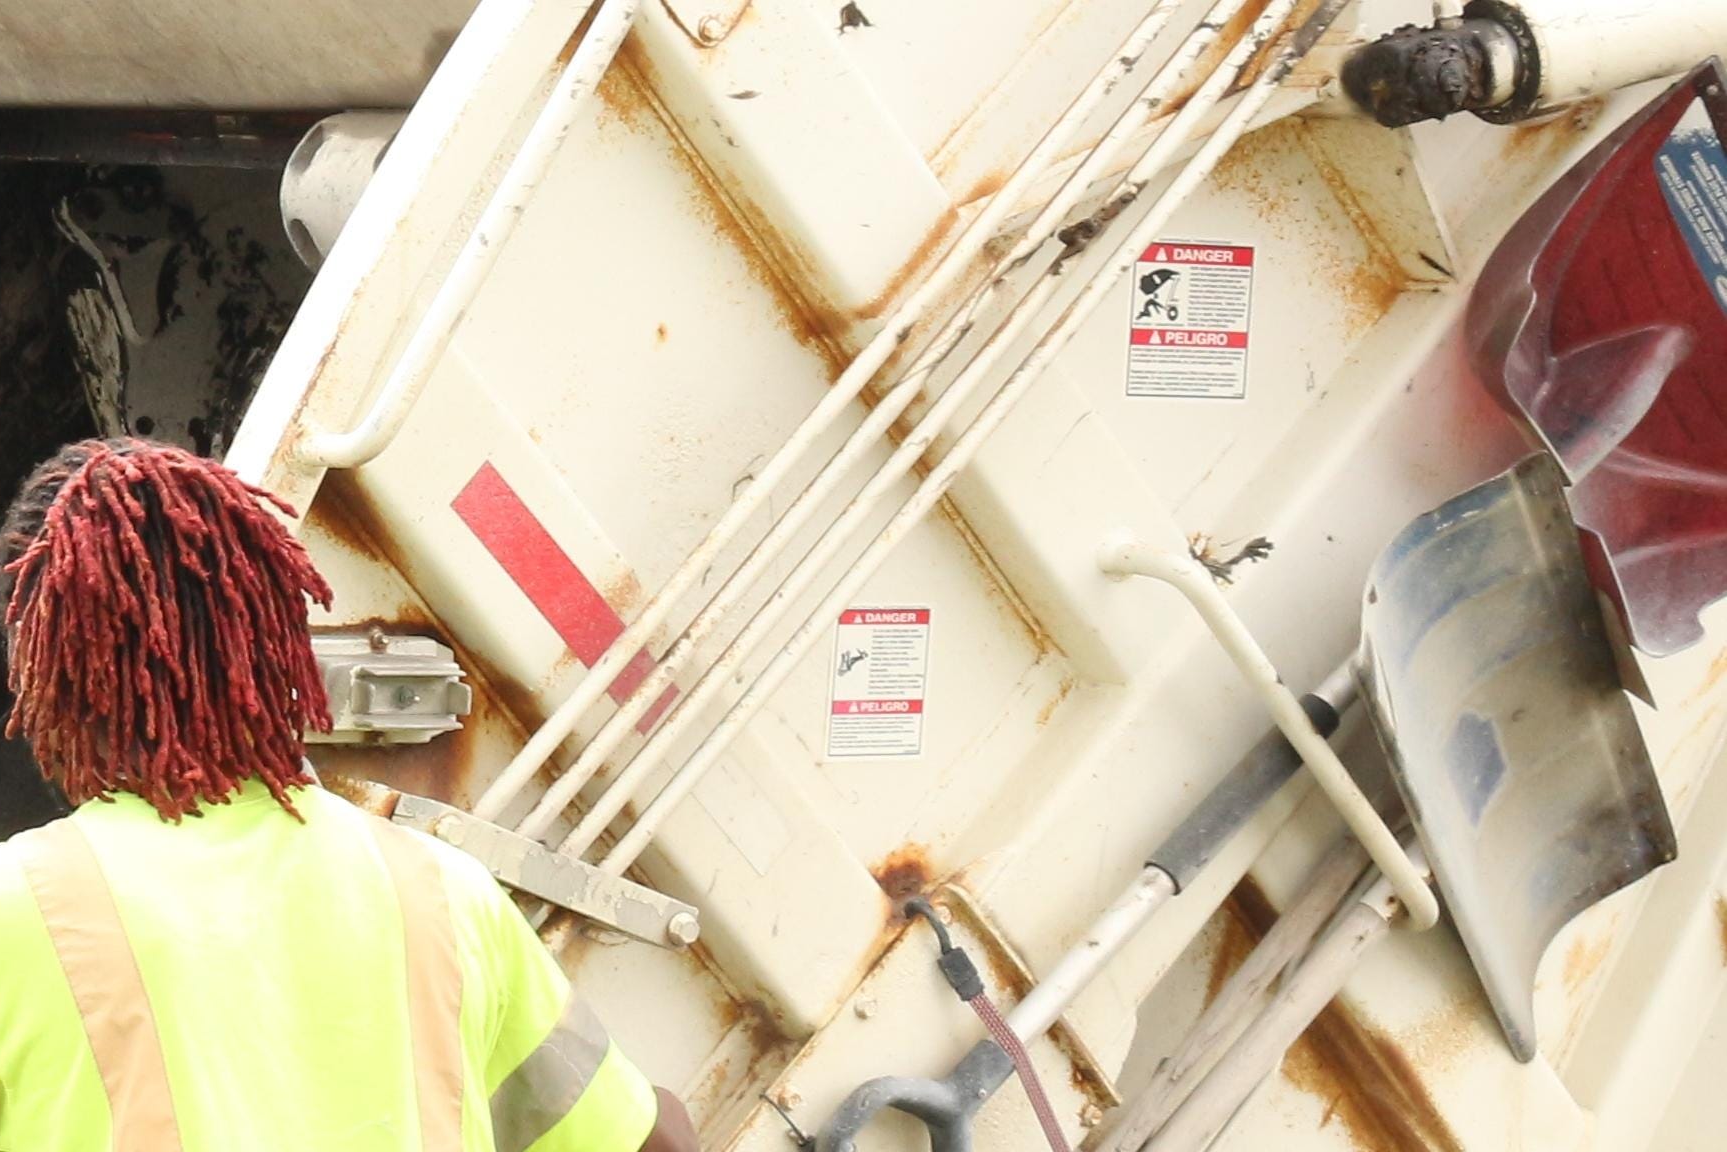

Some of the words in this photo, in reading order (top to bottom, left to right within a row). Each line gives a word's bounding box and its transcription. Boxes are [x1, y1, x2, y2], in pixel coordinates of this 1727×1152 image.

[1173, 248, 1234, 263] DANGER
[1165, 331, 1228, 346] PELIGRO
[865, 613, 916, 624] DANGER
[861, 702, 909, 713] PELIGRO
